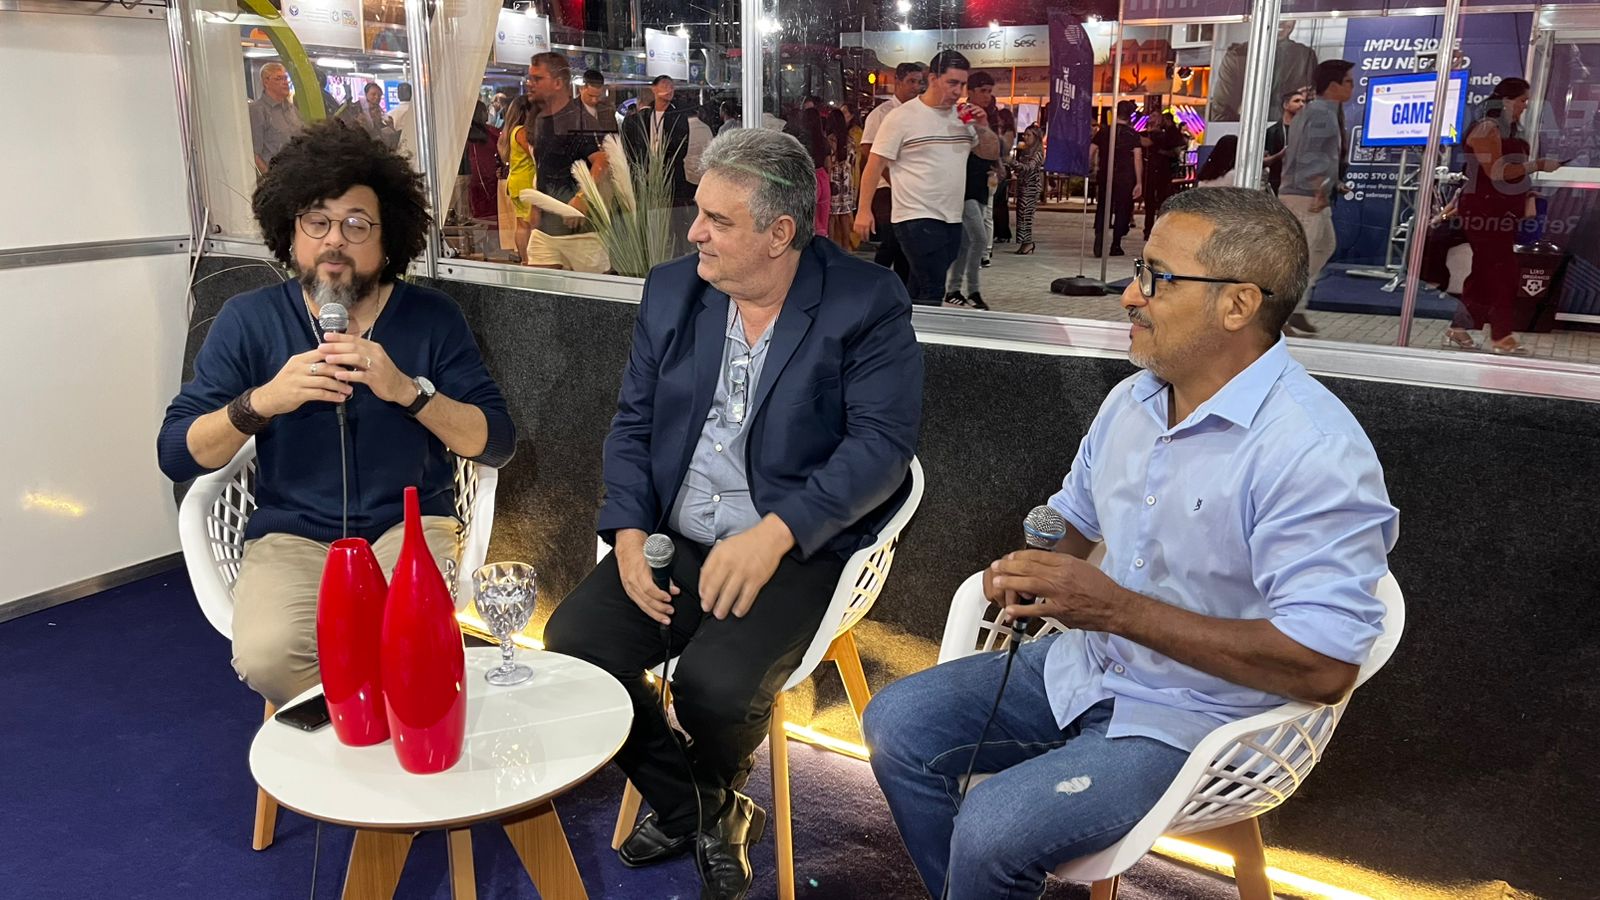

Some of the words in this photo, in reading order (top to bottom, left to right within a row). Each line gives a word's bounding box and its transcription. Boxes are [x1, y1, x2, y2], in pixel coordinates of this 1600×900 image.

[989, 41, 1001, 49] PE
[1014, 38, 1037, 48] Sesc
[1364, 38, 1462, 52] IMPULSIOE
[1361, 58, 1393, 70] SEU
[1061, 66, 1070, 110] SEBRAE
